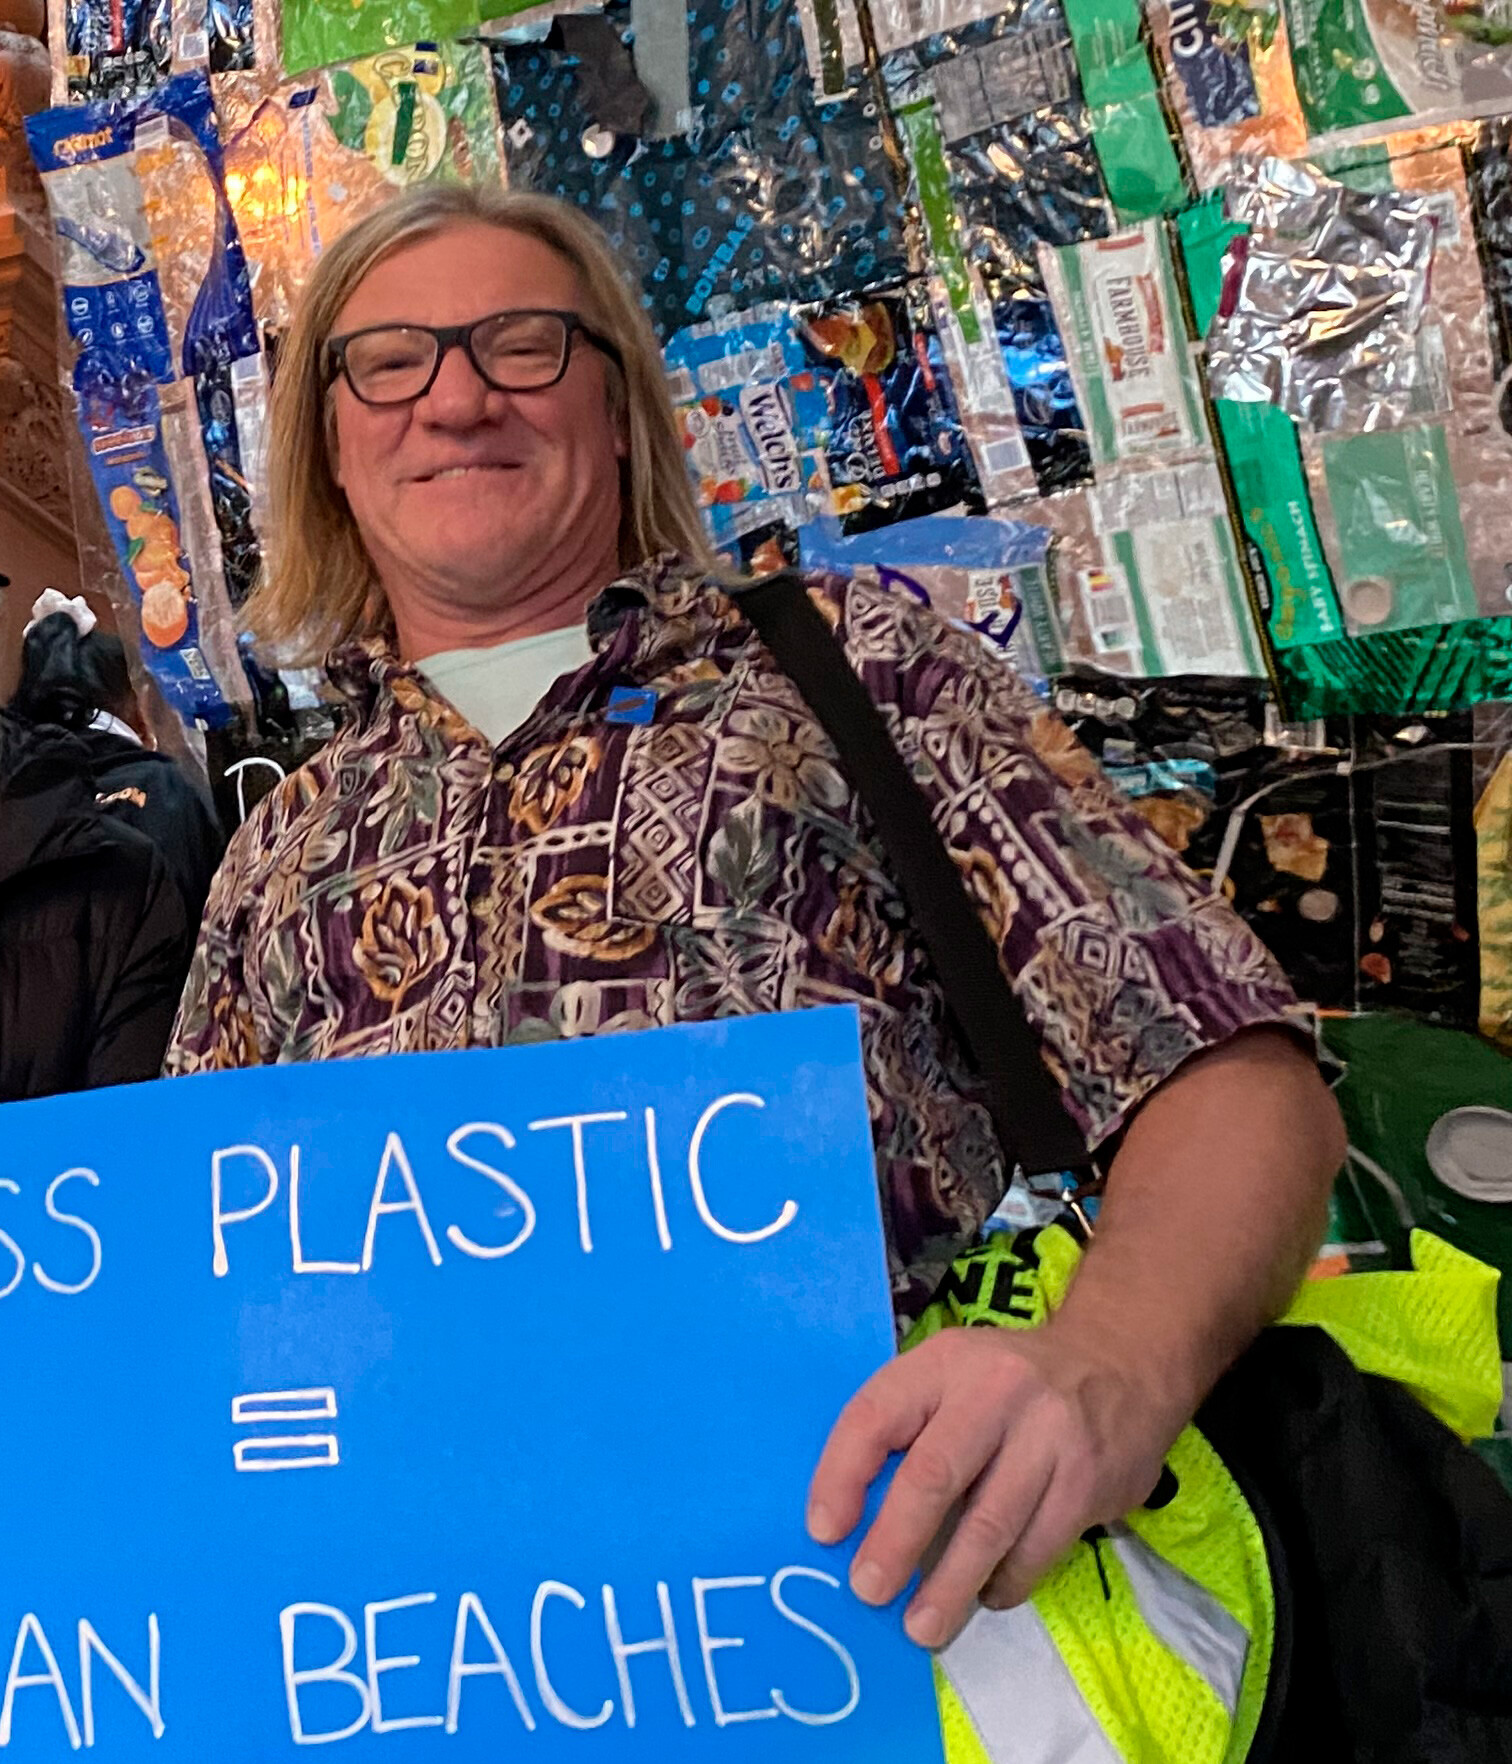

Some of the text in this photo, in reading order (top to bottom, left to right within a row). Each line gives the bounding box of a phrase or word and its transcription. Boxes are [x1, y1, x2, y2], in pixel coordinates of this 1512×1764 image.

[685, 211, 756, 315] BOMBAS
[1106, 275, 1150, 379] FARMHOUSE
[749, 392, 795, 489] Welch's
[1287, 498, 1333, 633] BABY SPINACH
[211, 1092, 798, 1278] PLASTIC
[280, 1565, 859, 1745] BEACHES
